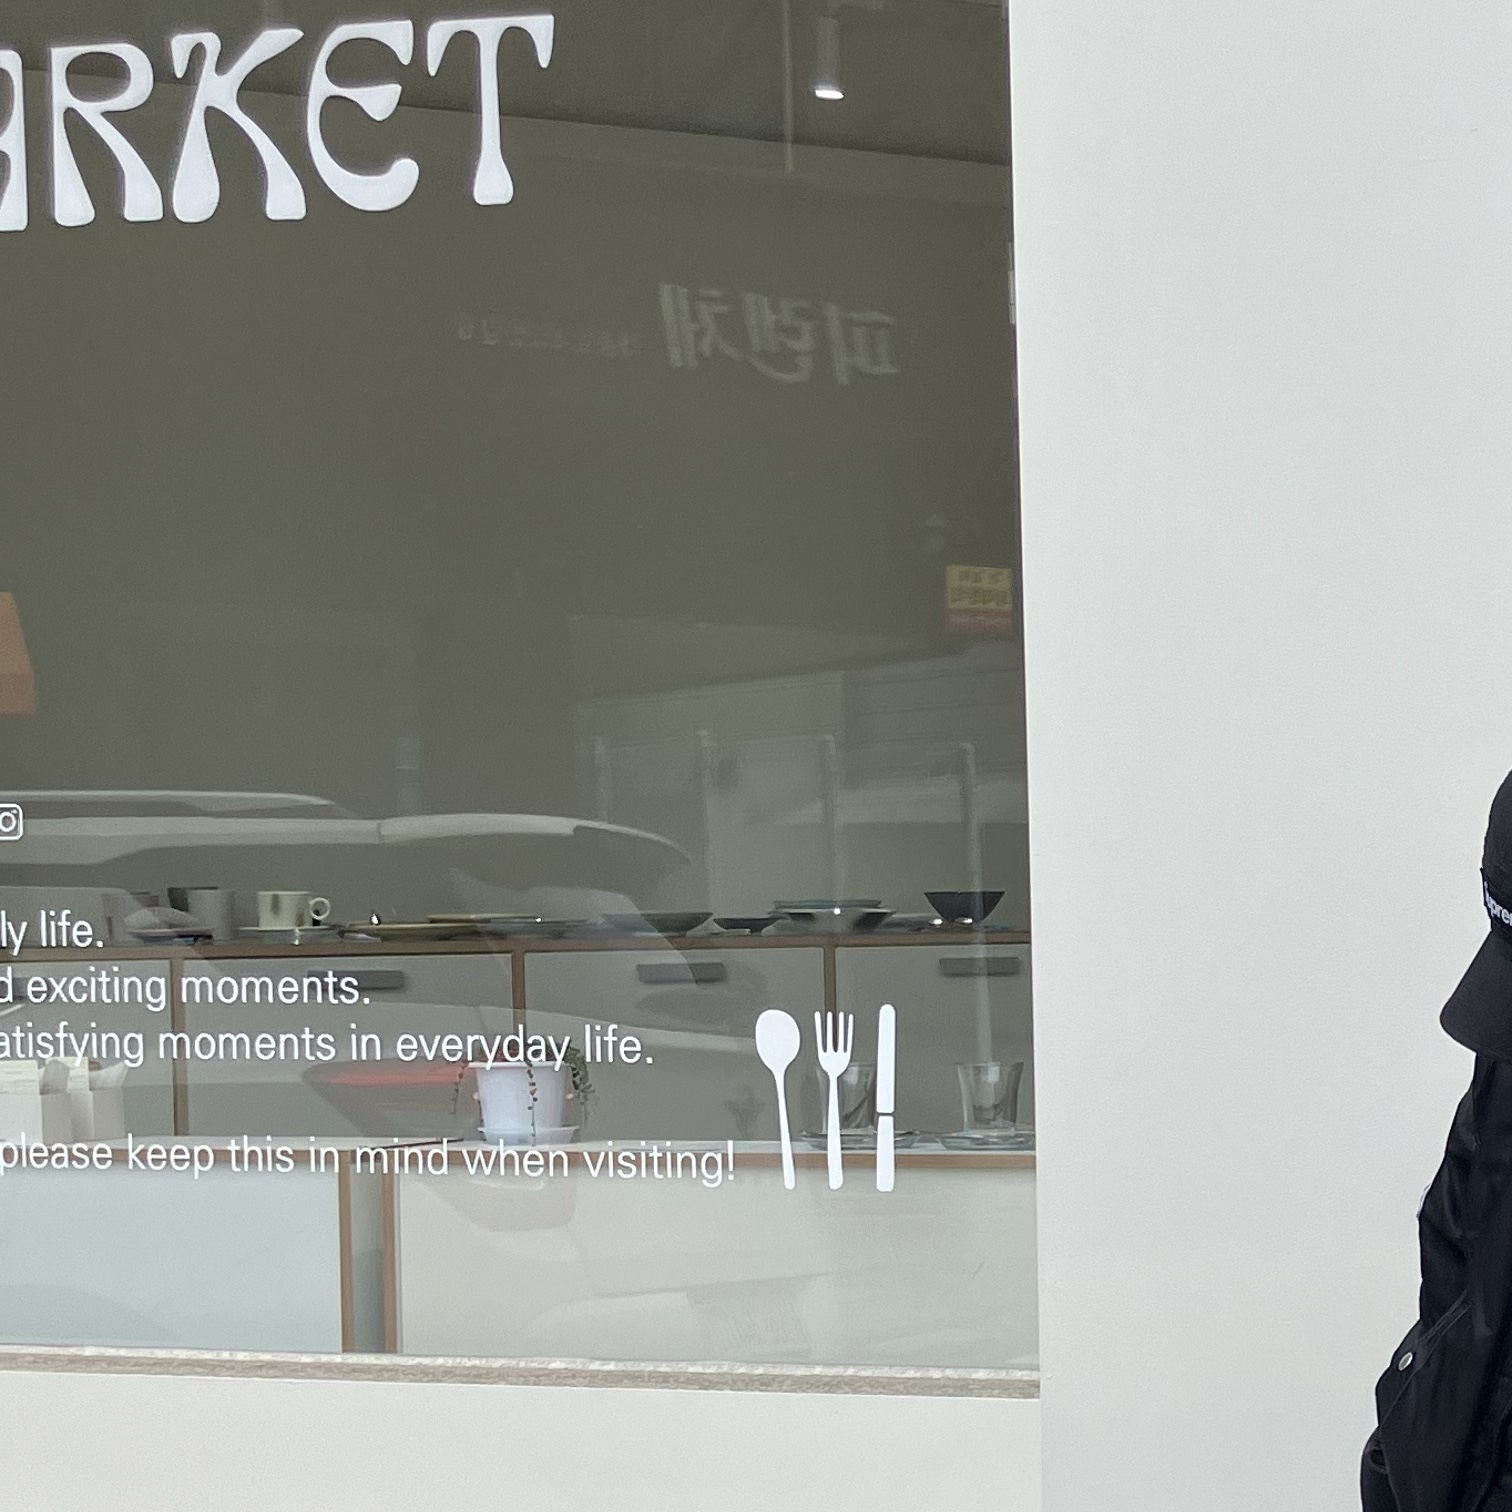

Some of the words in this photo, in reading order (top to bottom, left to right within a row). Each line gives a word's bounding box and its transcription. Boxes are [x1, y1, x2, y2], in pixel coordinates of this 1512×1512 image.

[40, 909, 104, 948] life.
[27, 965, 166, 1012] exciting
[181, 970, 370, 1005] moments.
[159, 1027, 336, 1061] moments
[350, 1023, 381, 1061] in
[396, 1024, 571, 1072] everyday
[585, 1024, 653, 1064] life.
[0, 1131, 113, 1176] please
[127, 1132, 214, 1180] keep
[226, 1134, 295, 1173] this
[309, 1136, 339, 1173] in
[355, 1137, 449, 1176] mind
[461, 1139, 569, 1177] when
[583, 1139, 735, 1189] visiting!
